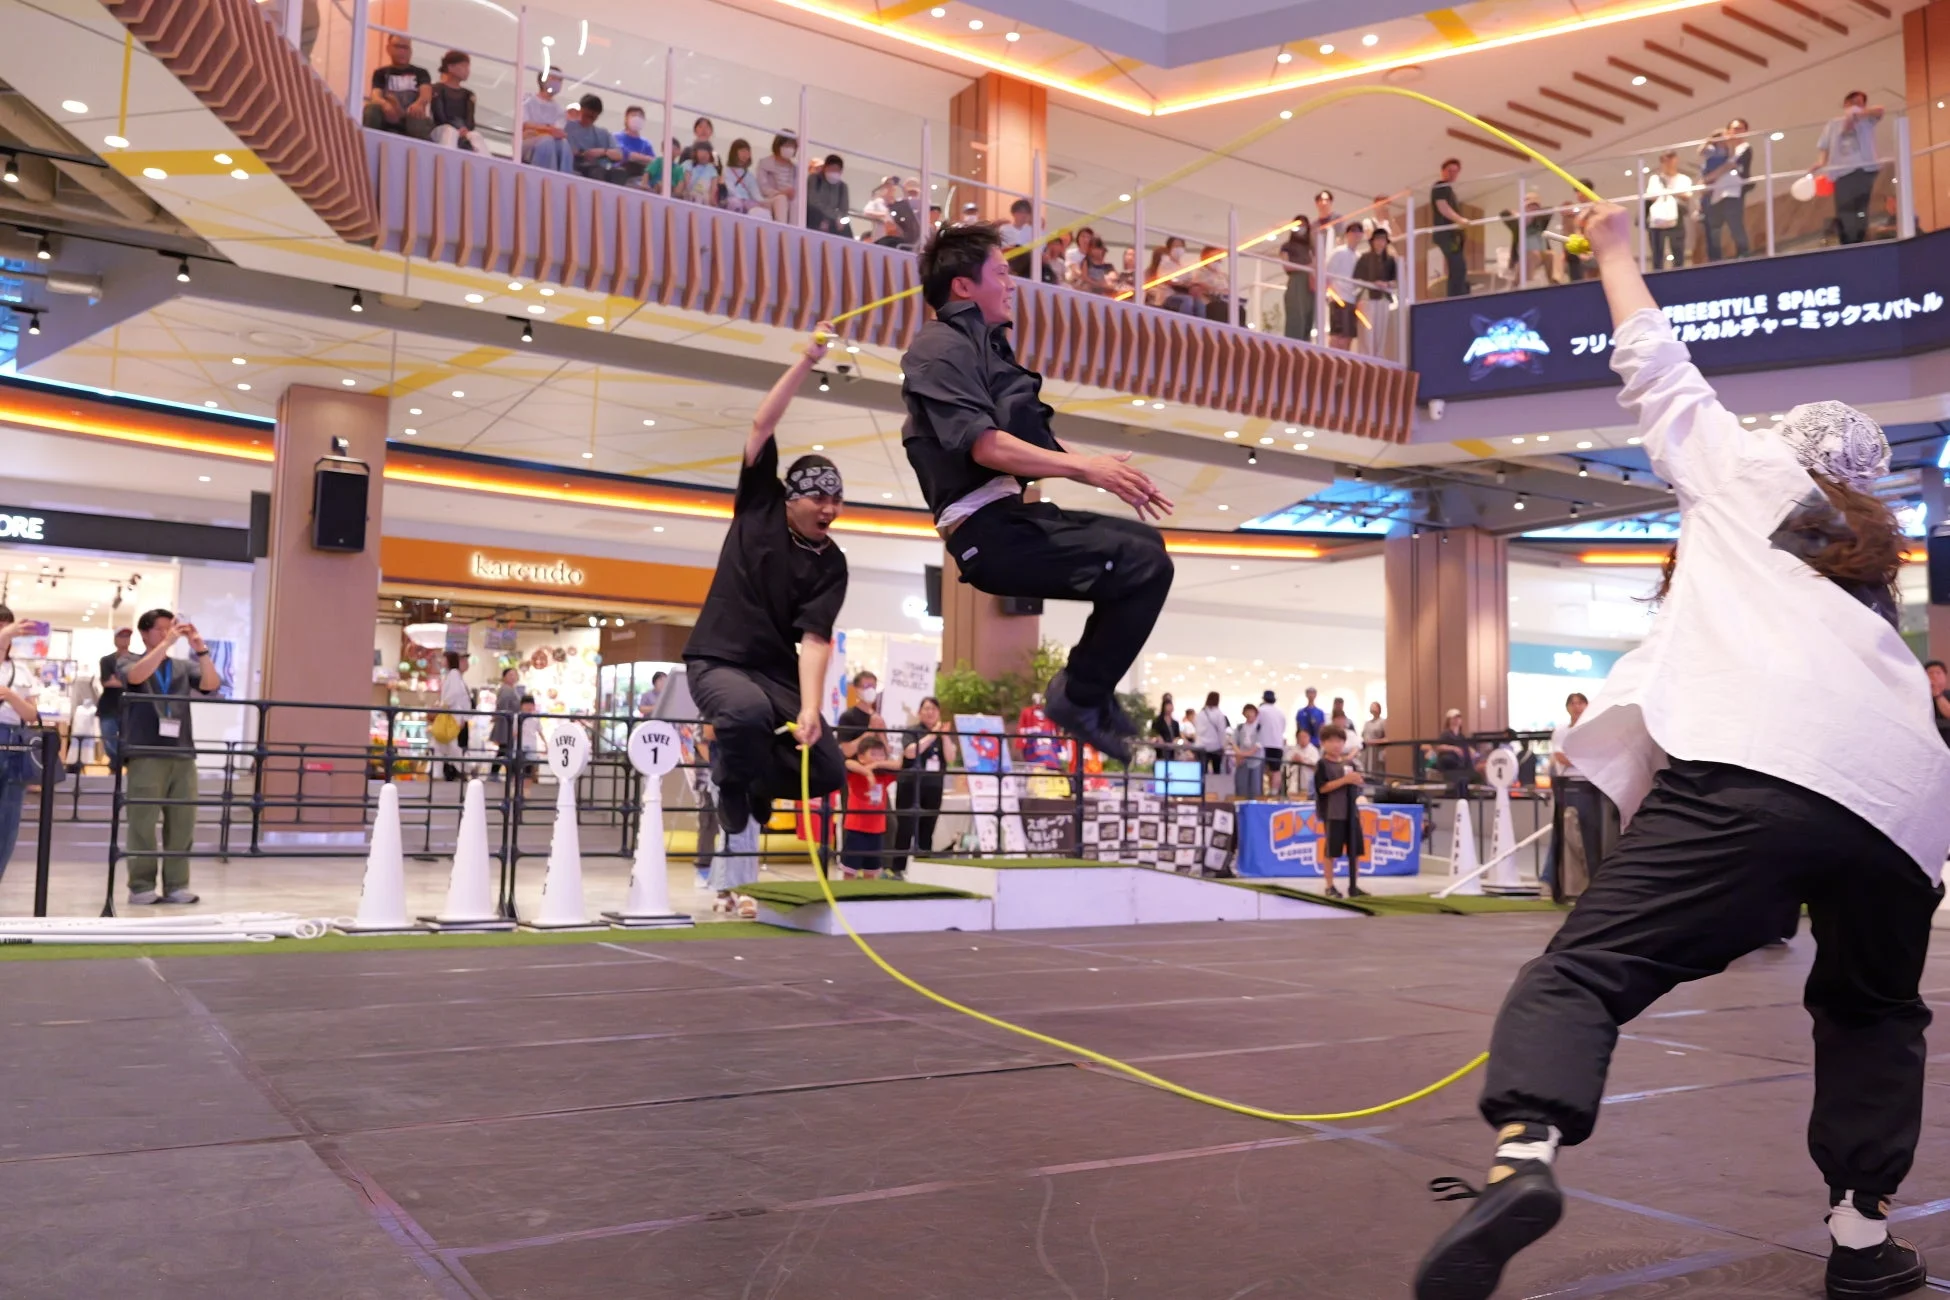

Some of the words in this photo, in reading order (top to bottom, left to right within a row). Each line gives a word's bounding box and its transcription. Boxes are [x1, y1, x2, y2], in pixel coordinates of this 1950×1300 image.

[1662, 296, 1768, 323] FREESTYLE
[1777, 286, 1841, 310] SPACE
[0, 514, 45, 540] ORE
[473, 551, 584, 585] karendo
[555, 735, 576, 748] LEVEL
[642, 734, 671, 745] LEVEL
[561, 748, 569, 767] 3
[650, 747, 659, 764] 1
